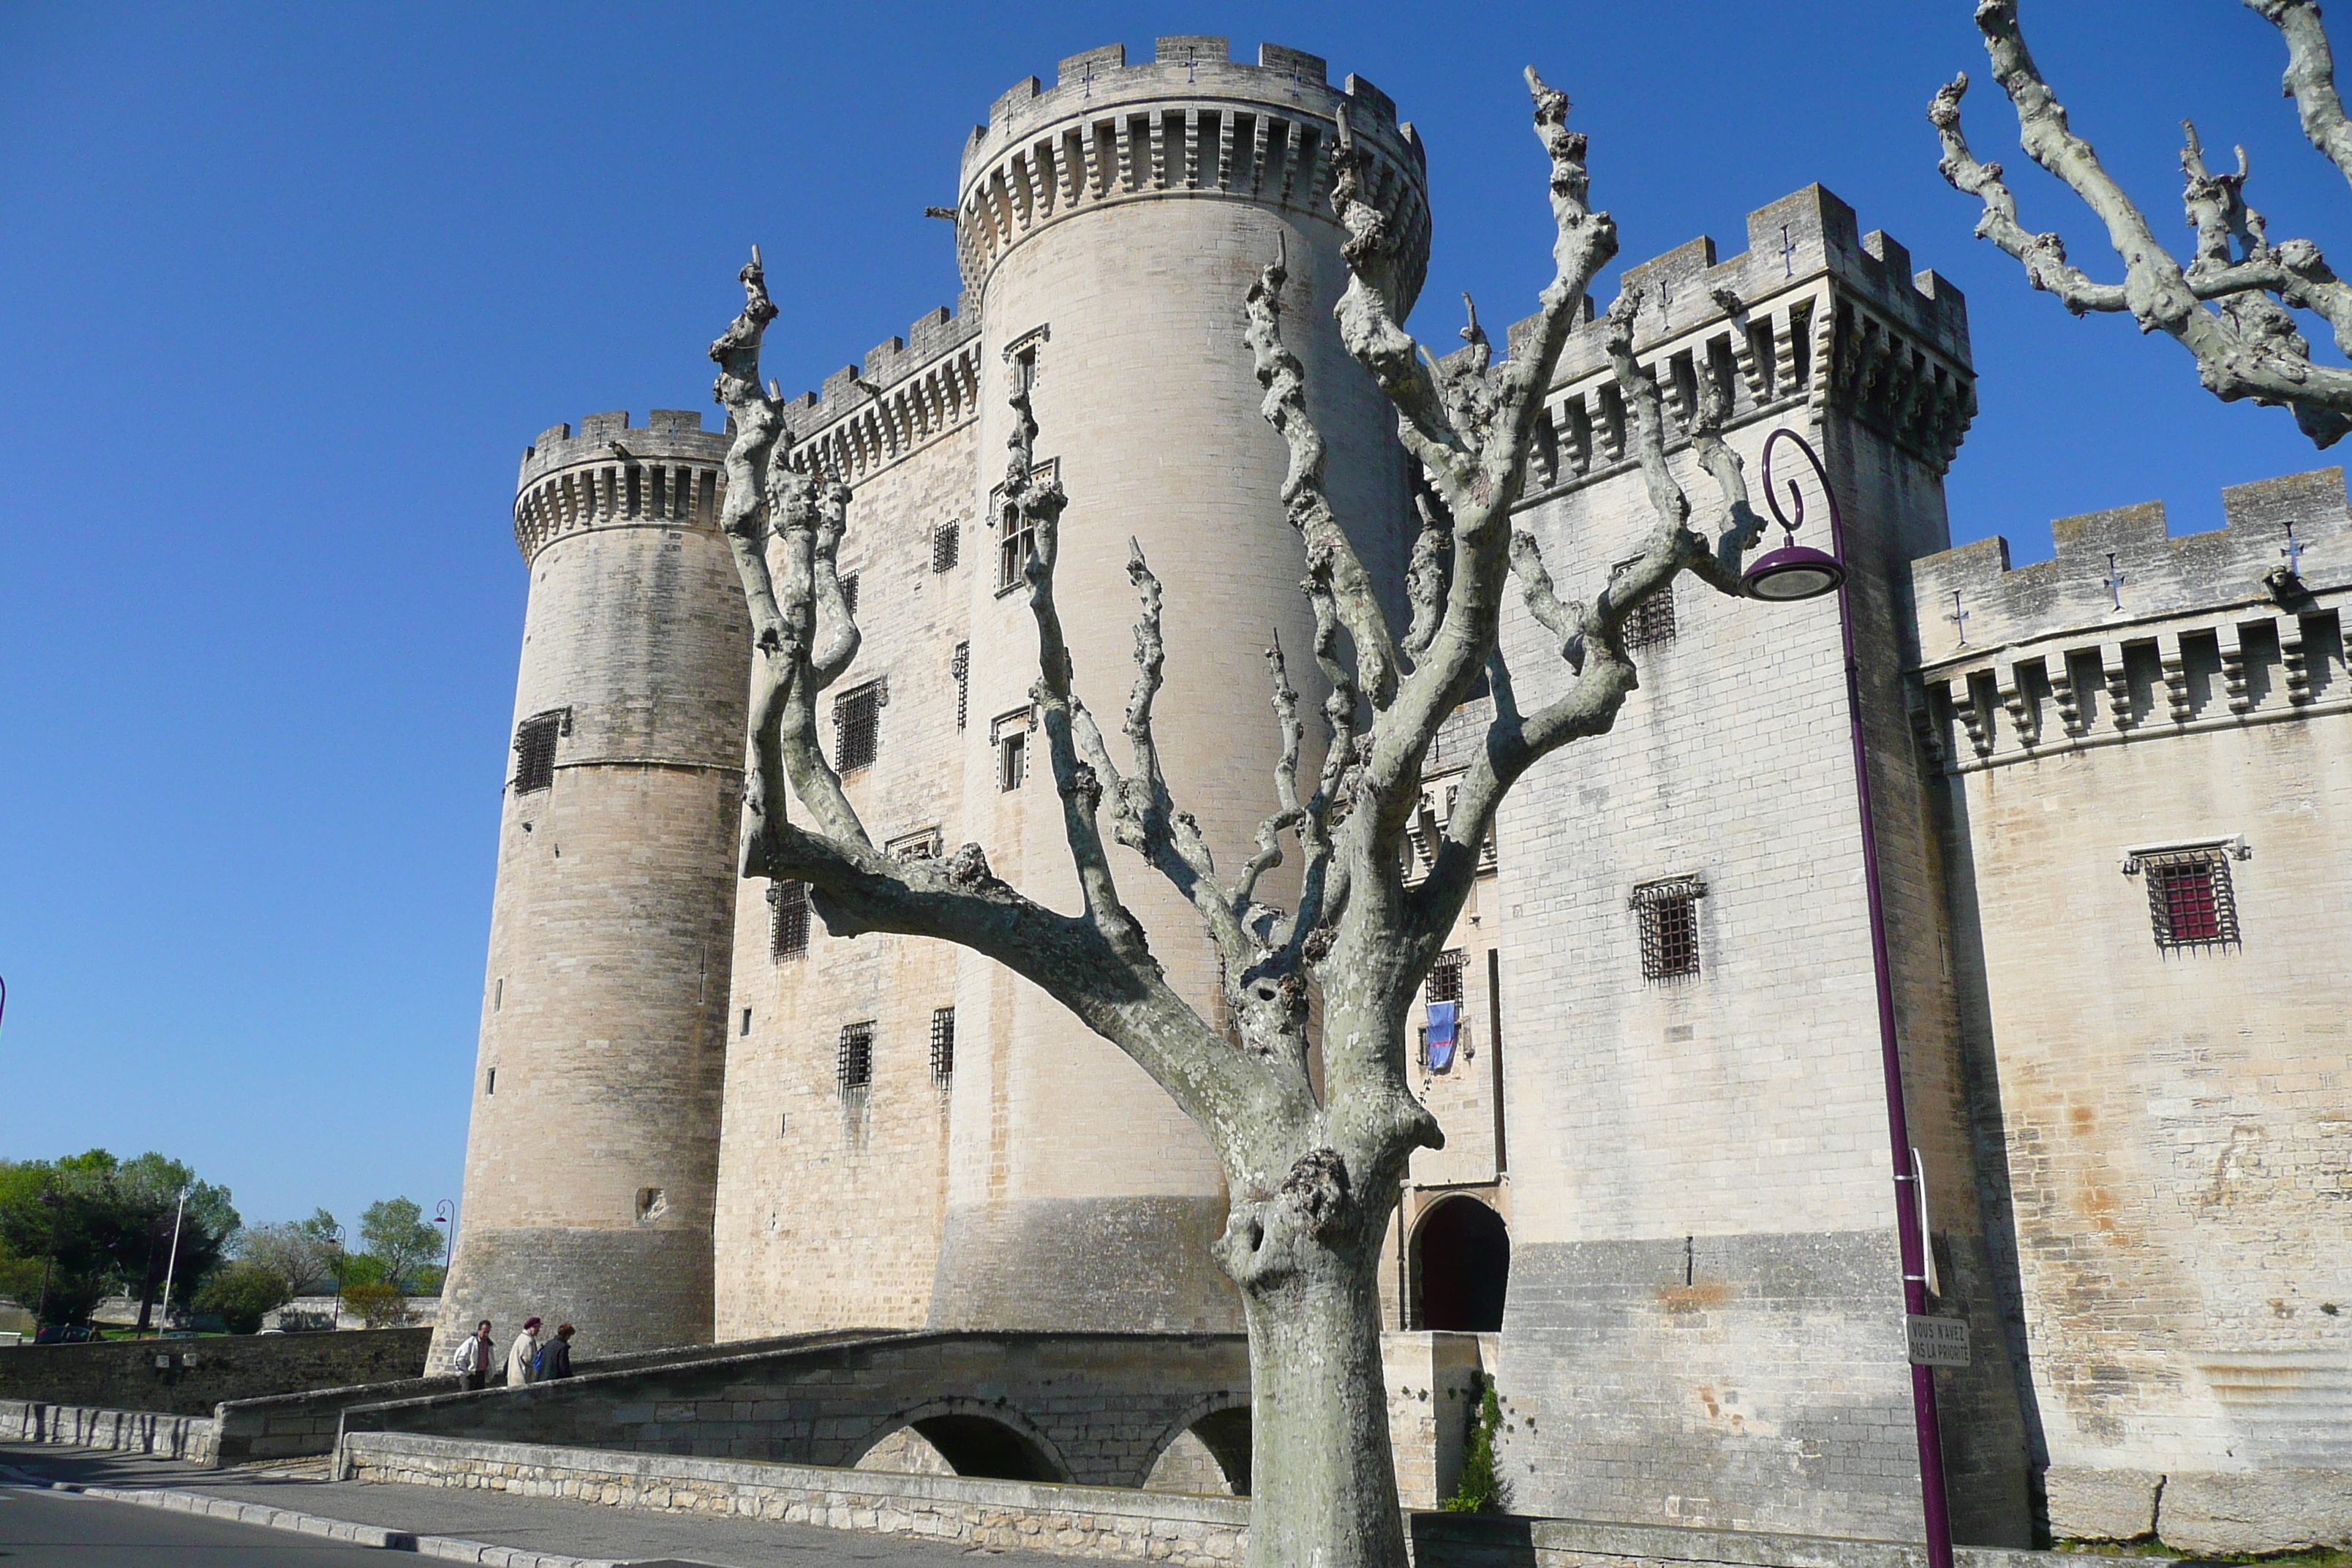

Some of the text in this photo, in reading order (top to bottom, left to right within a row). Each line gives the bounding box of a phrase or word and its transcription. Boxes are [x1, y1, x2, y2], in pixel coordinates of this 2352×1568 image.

[1912, 1322, 1964, 1341] VOUS N'AVEZ
[1910, 1341, 1969, 1360] PAS LA PRIORITÉ
